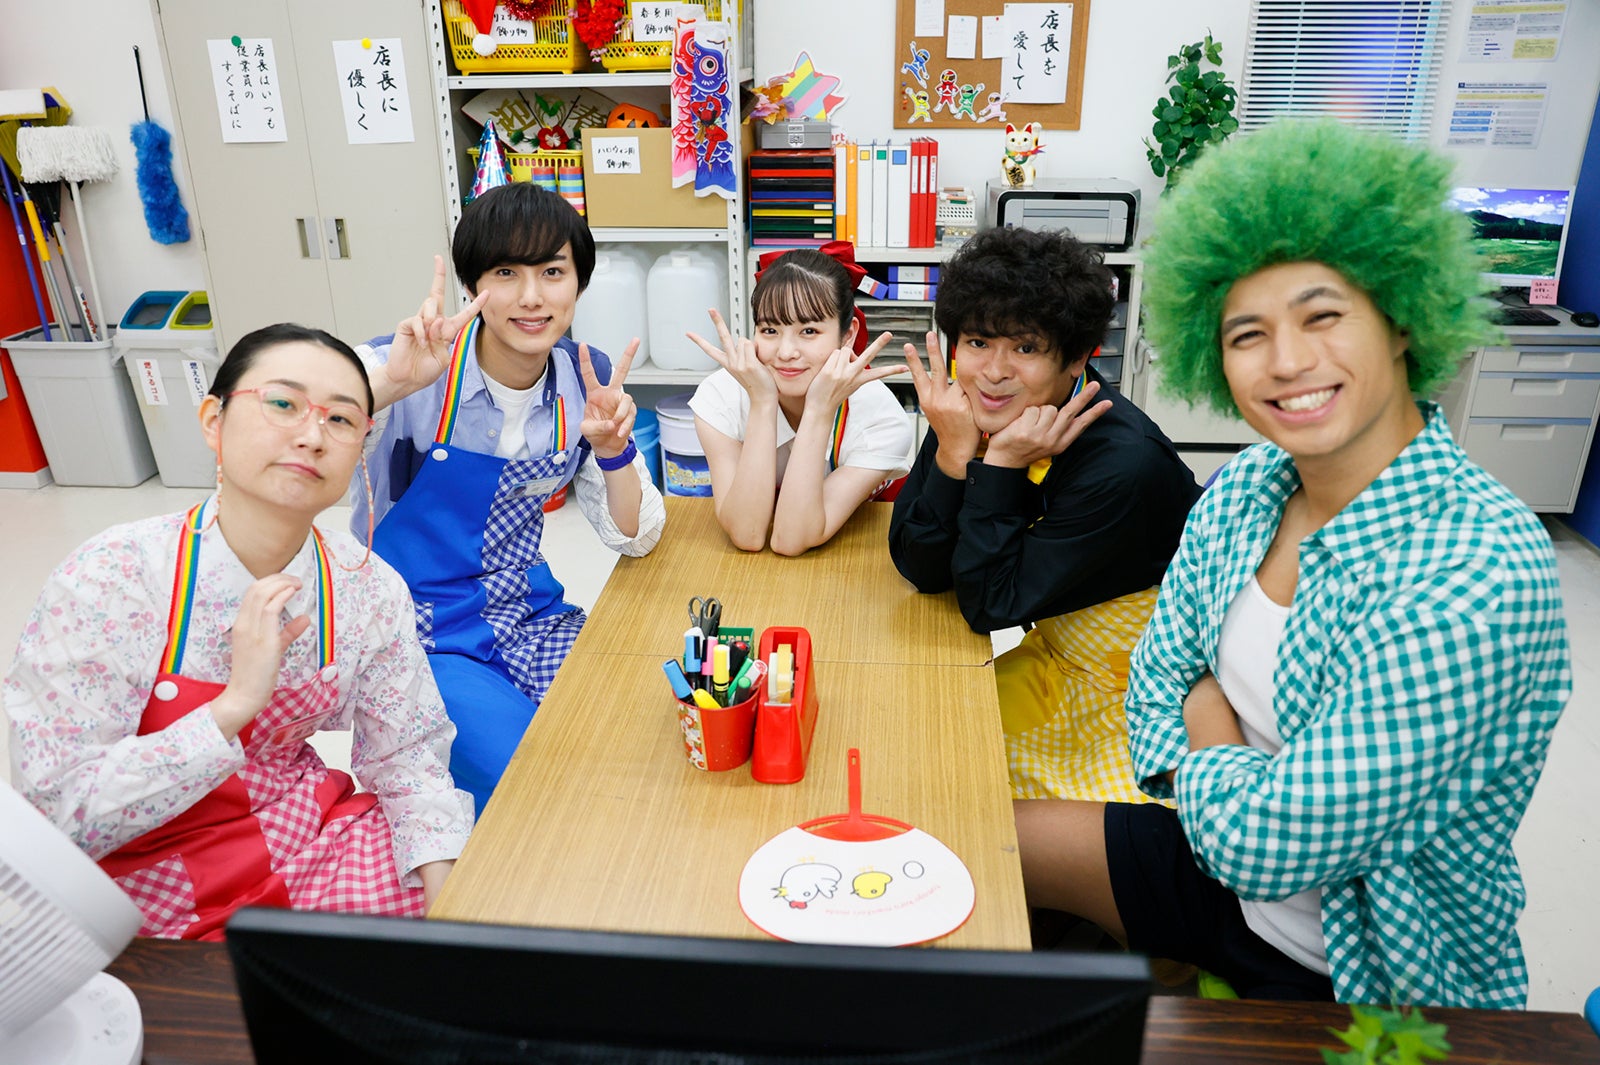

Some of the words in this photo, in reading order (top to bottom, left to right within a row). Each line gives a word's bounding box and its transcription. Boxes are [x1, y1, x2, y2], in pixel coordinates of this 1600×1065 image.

[496, 26, 528, 37] 飾り物
[1012, 30, 1029, 91] 愛して
[1041, 9, 1060, 76] 店長を
[221, 60, 242, 129] すぐそばに
[237, 45, 254, 100] 従業員の
[253, 43, 276, 130] 店長はいつも
[347, 68, 369, 131] 優しく
[373, 45, 399, 113] 店長に
[143, 360, 160, 402] 燃えるゴミ
[189, 361, 205, 400] 燃えないゴ
